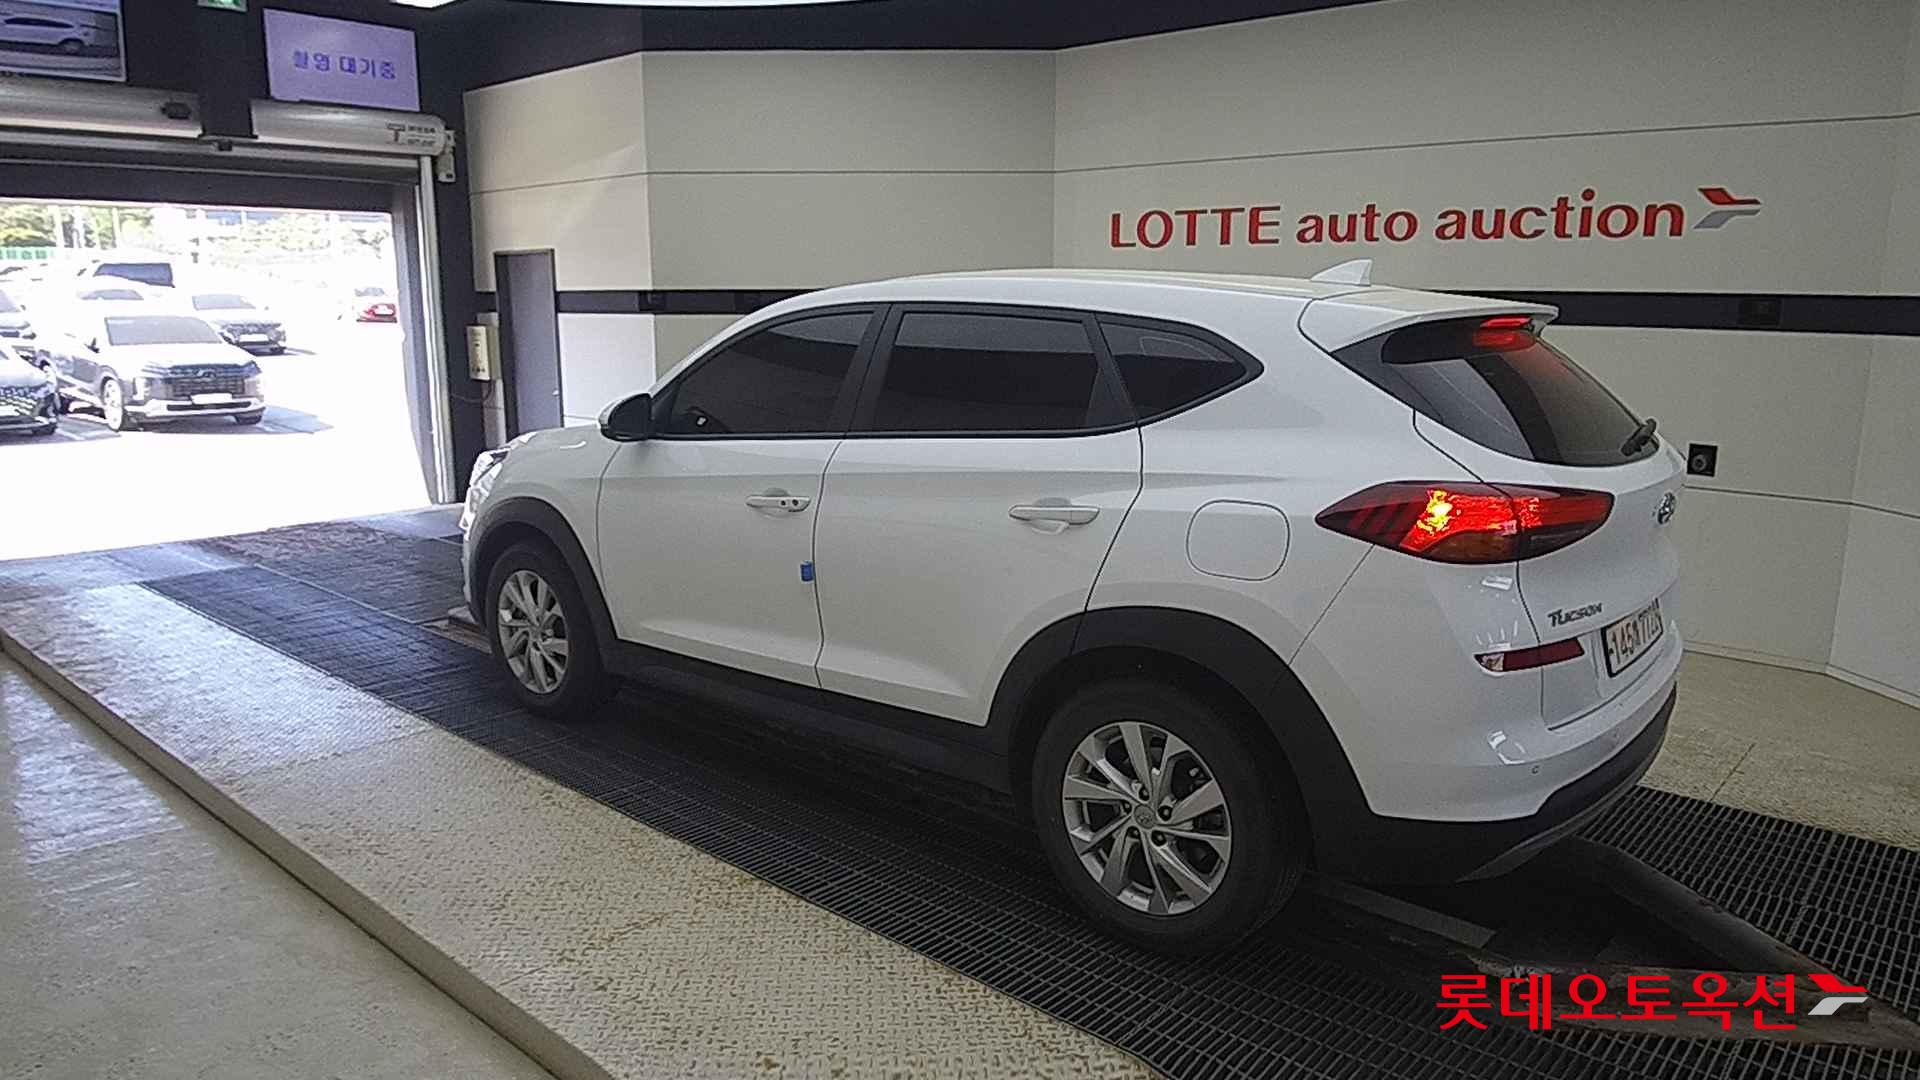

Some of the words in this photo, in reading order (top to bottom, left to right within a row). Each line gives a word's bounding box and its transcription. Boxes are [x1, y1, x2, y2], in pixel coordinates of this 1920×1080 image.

[339, 55, 396, 80] 대기중
[1110, 205, 1281, 249] LOTTE
[1296, 203, 1418, 243] auto
[1434, 188, 1685, 241] auction
